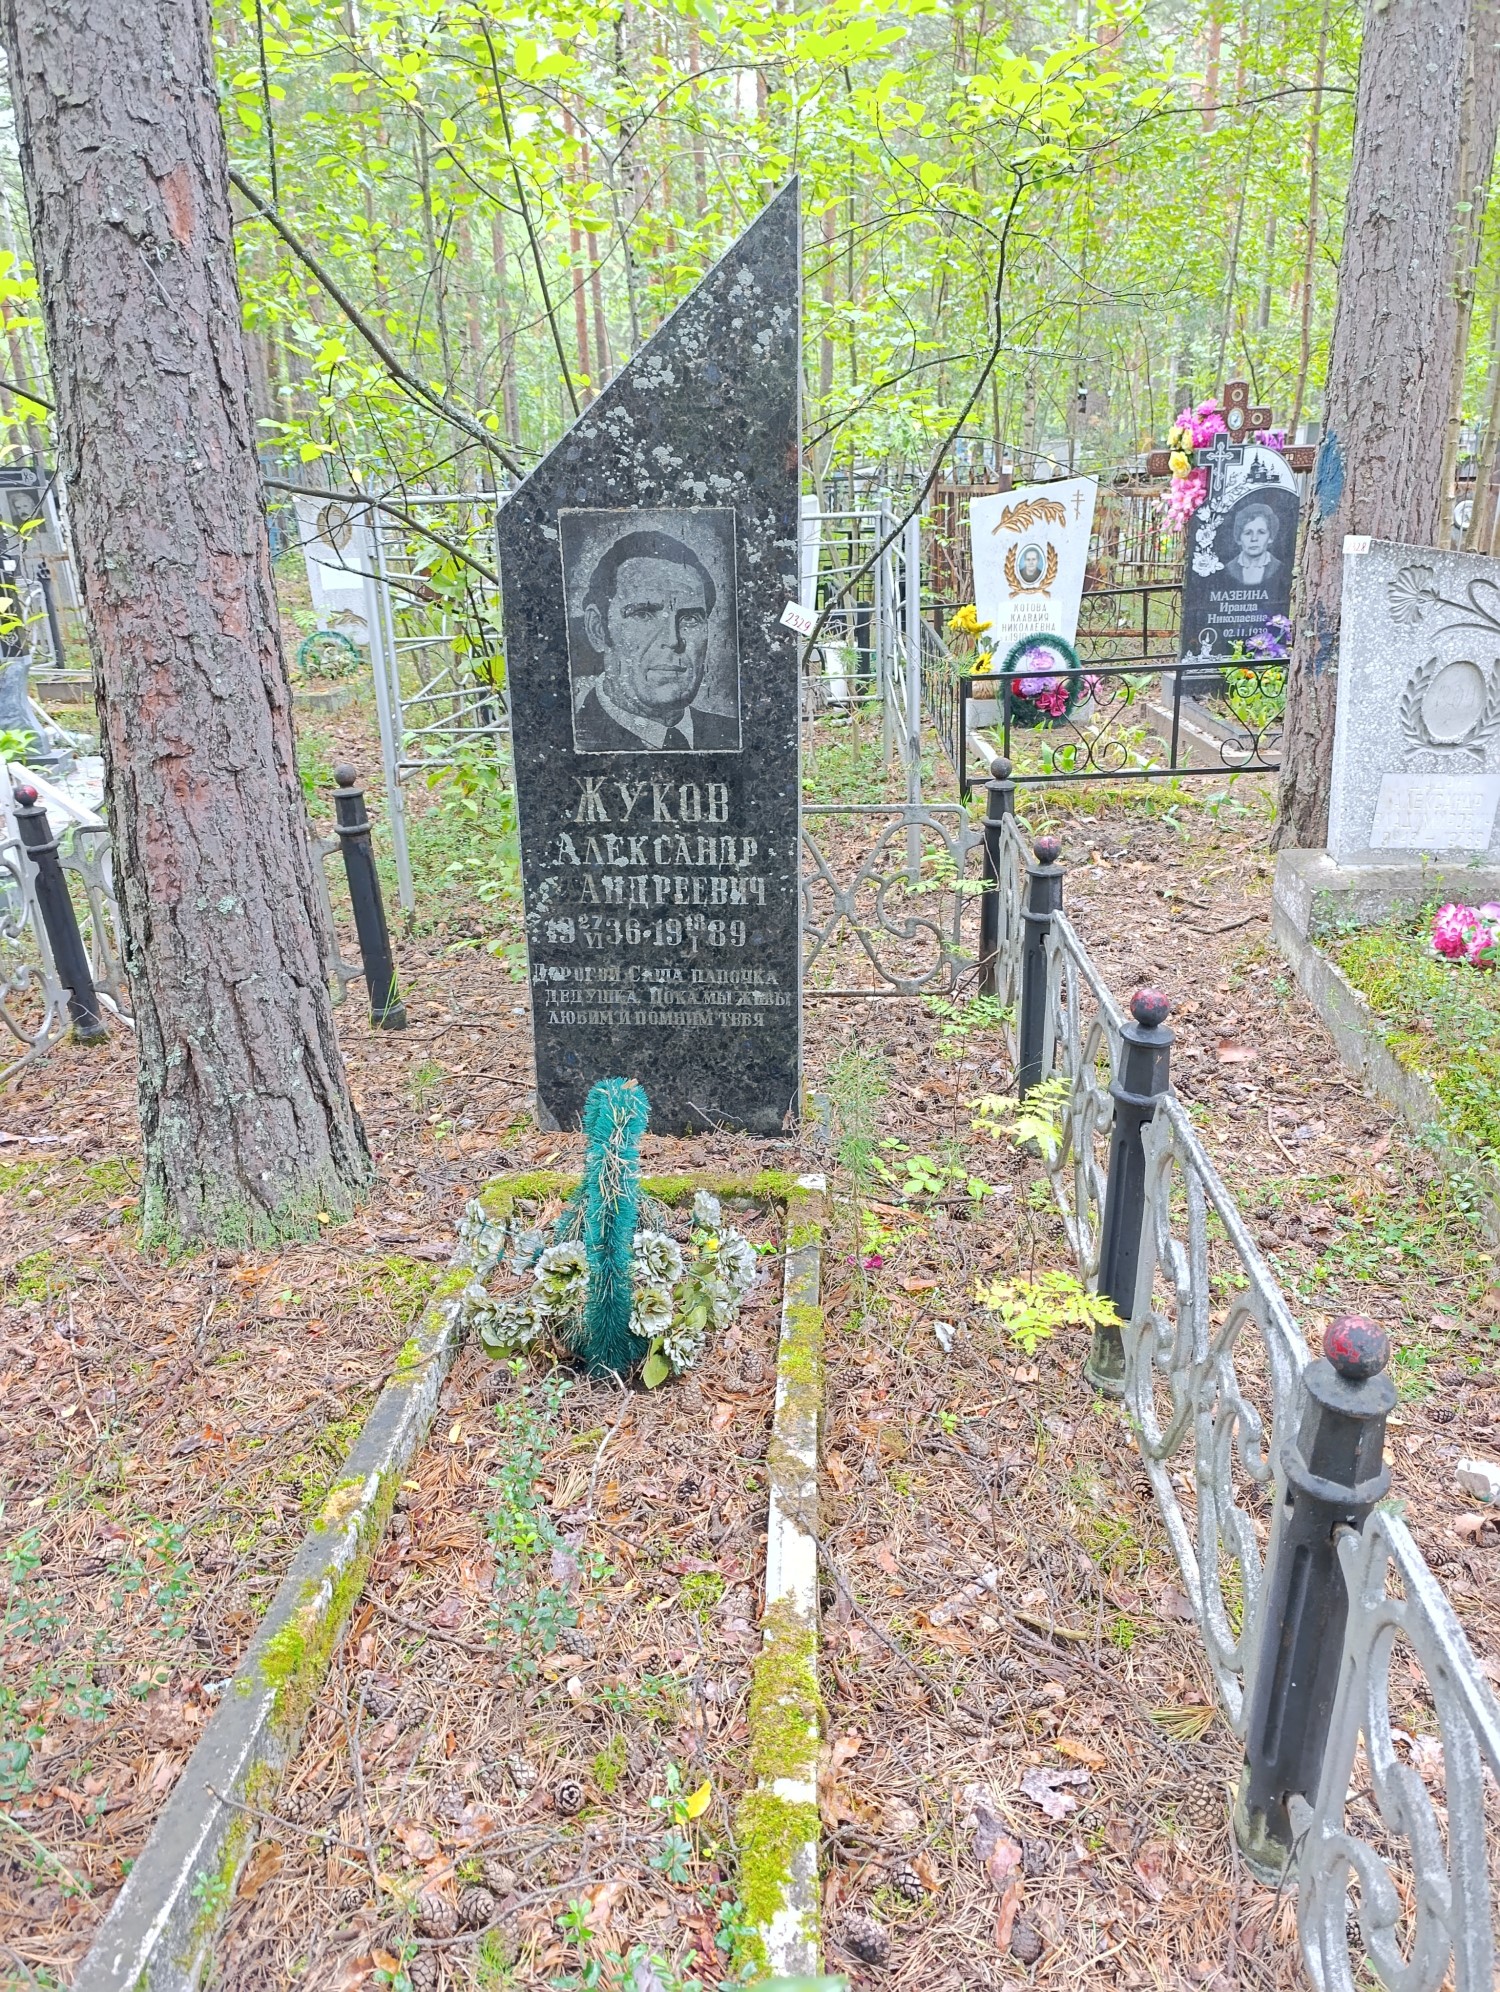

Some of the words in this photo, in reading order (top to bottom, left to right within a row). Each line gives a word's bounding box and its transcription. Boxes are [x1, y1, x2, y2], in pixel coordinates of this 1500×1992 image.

[1210, 590, 1269, 602] МАЗЕИНА
[1013, 603, 1047, 613] КОТОВА
[1219, 602, 1258, 614] Ираида
[785, 612, 812, 632] 2329
[1010, 613, 1049, 622] КЛАВДИЯ
[1207, 614, 1268, 624] Николаевна
[1001, 623, 1056, 633] НИКОЛАЕВНА
[572, 776, 729, 823] ЖУКОВ
[556, 832, 758, 871] АЛЕКСАНДР
[581, 873, 766, 910] АНДРЕЕВИЧ
[628, 965, 686, 983] САША
[691, 968, 779, 985] ПАПОЧКА
[545, 988, 641, 1007] ДЕДУШКА
[650, 987, 700, 1005] ПОКА
[703, 990, 733, 1005] МЫ
[547, 1009, 614, 1026] ЛЮБИМ
[618, 1010, 632, 1026] И
[634, 1010, 714, 1027] ПОМНИМ
[719, 1012, 765, 1027] ТЕБЯ
